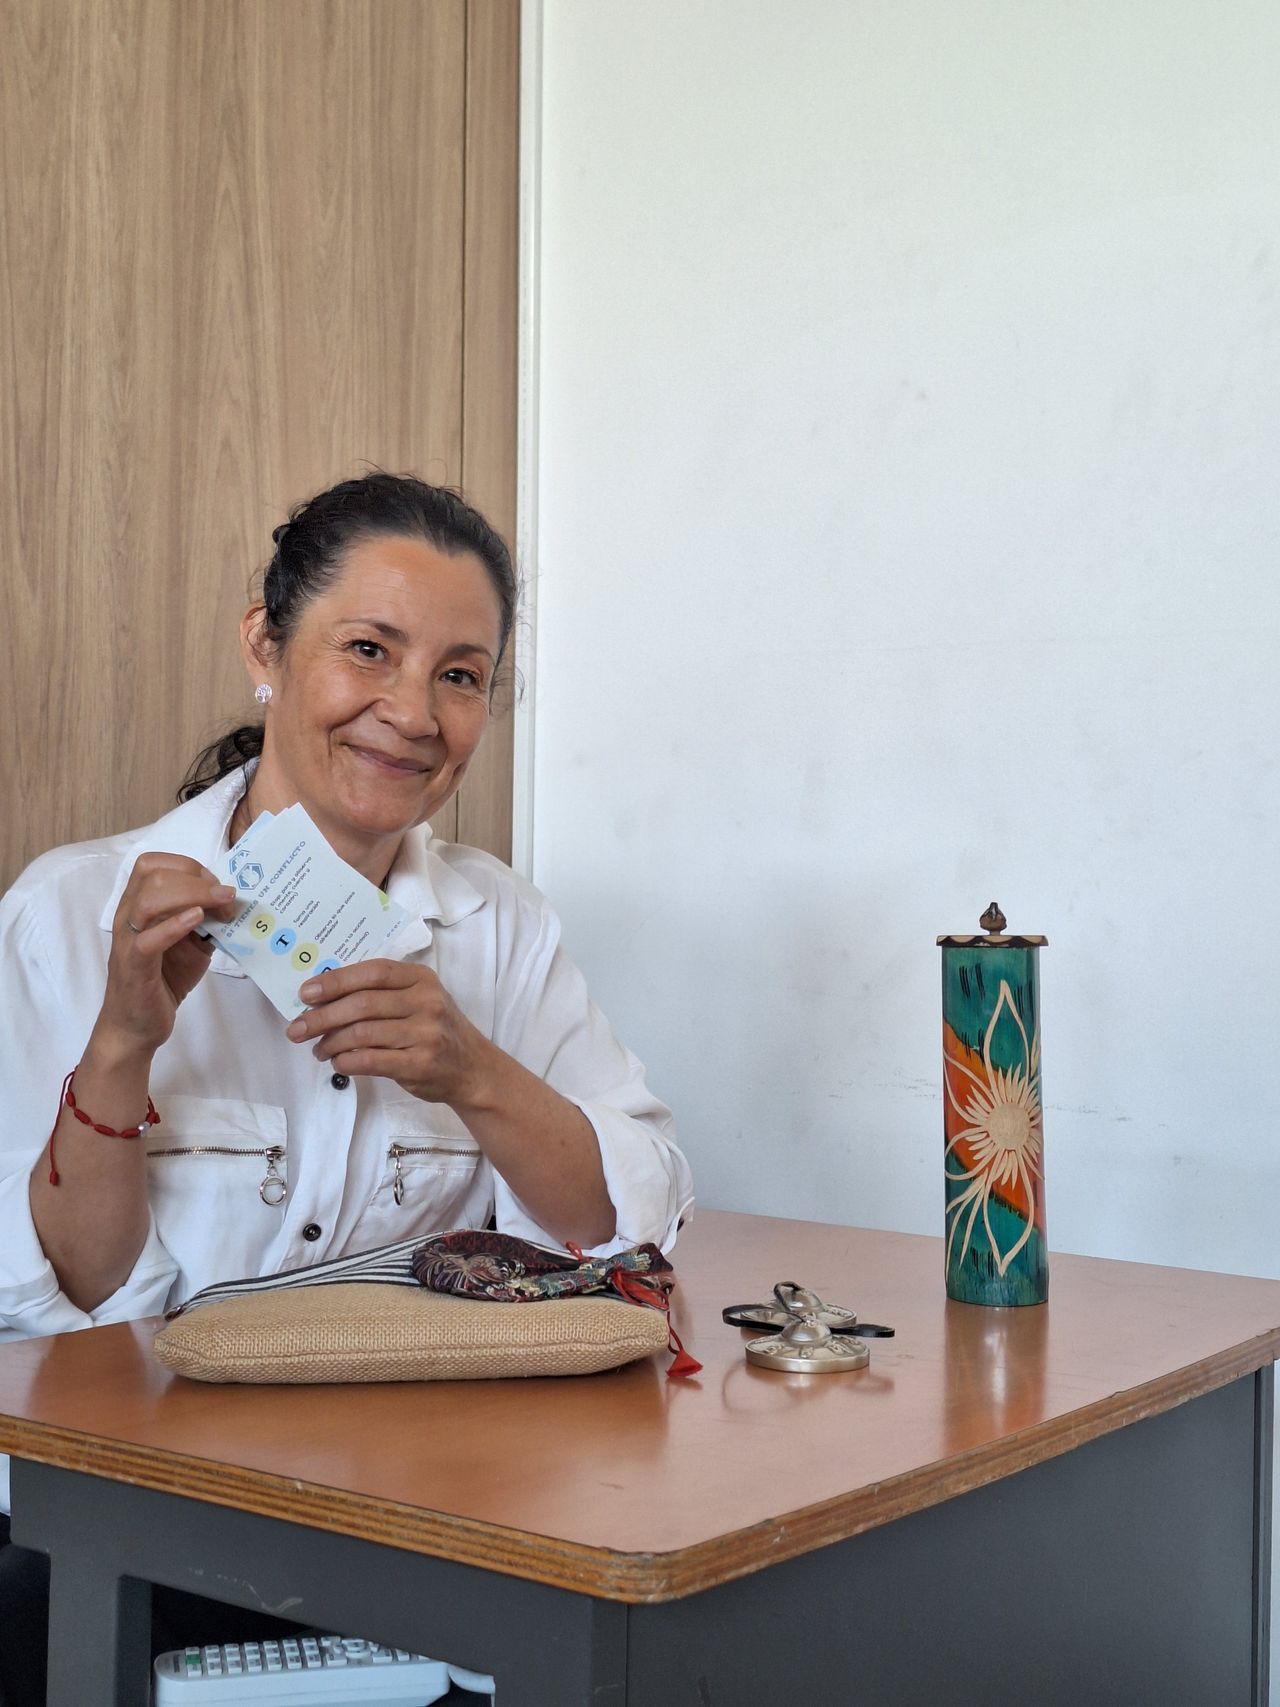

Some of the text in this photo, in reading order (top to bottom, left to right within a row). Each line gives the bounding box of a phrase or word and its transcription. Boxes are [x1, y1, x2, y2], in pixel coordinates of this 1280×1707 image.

[257, 885, 270, 898] UN
[269, 840, 306, 885] CONFLICTO
[255, 919, 269, 933] S
[275, 934, 290, 947] T
